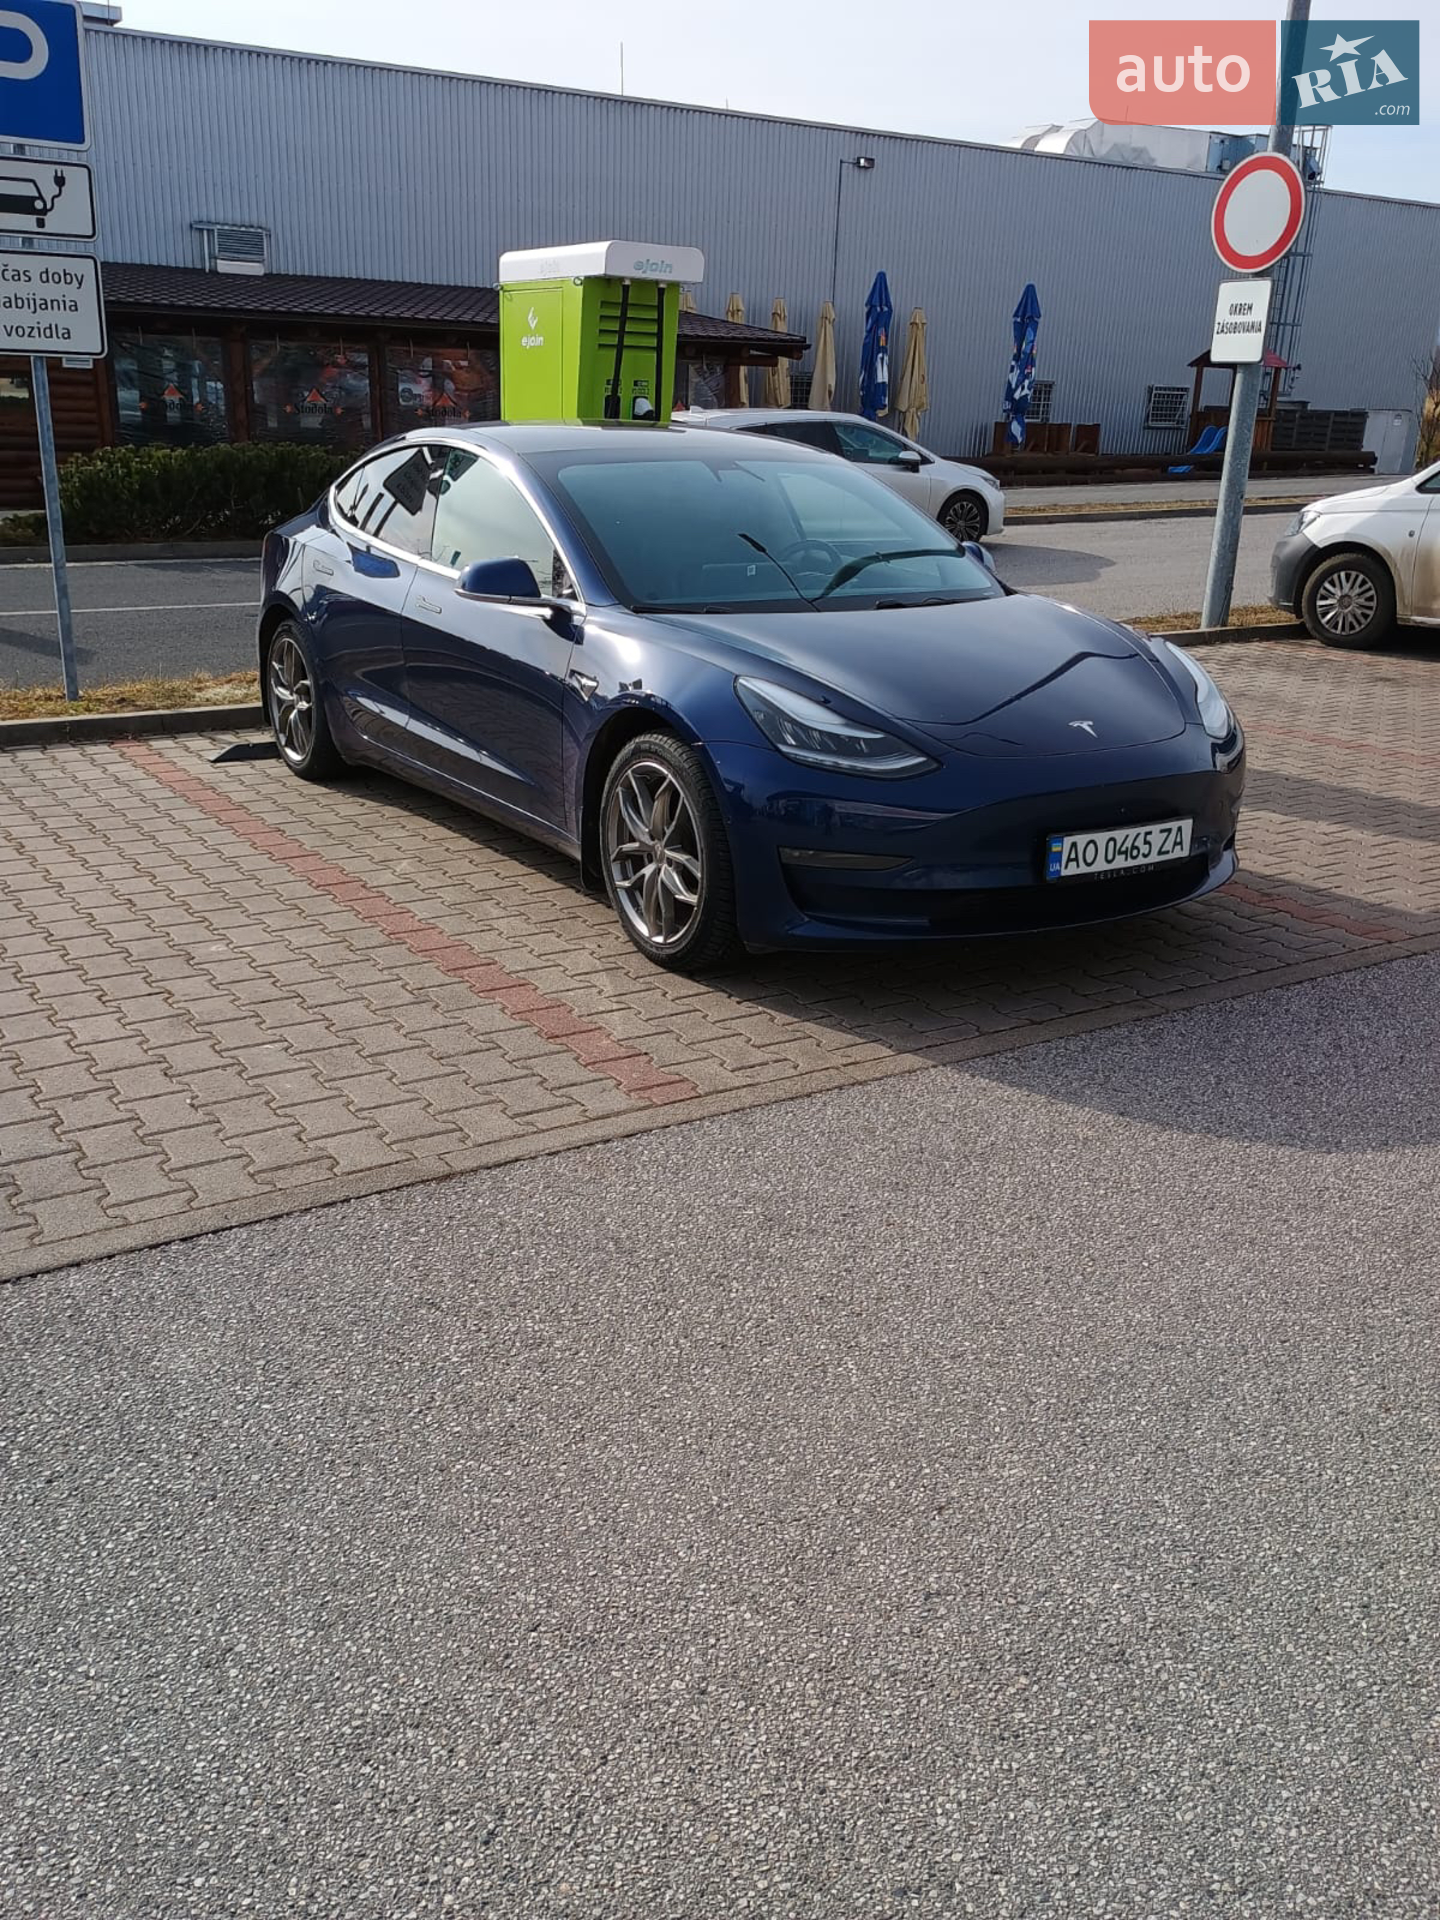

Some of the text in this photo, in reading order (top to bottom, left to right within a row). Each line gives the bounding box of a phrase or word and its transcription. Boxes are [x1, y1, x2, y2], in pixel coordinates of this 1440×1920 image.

[633, 258, 673, 275] ejoin
[39, 267, 85, 289] doby
[1229, 302, 1254, 316] OKREM
[3, 321, 72, 341] vozidla
[521, 334, 544, 350] ejoin
[1064, 825, 1184, 871] AO 0465 ZA
[1050, 863, 1060, 872] UA
